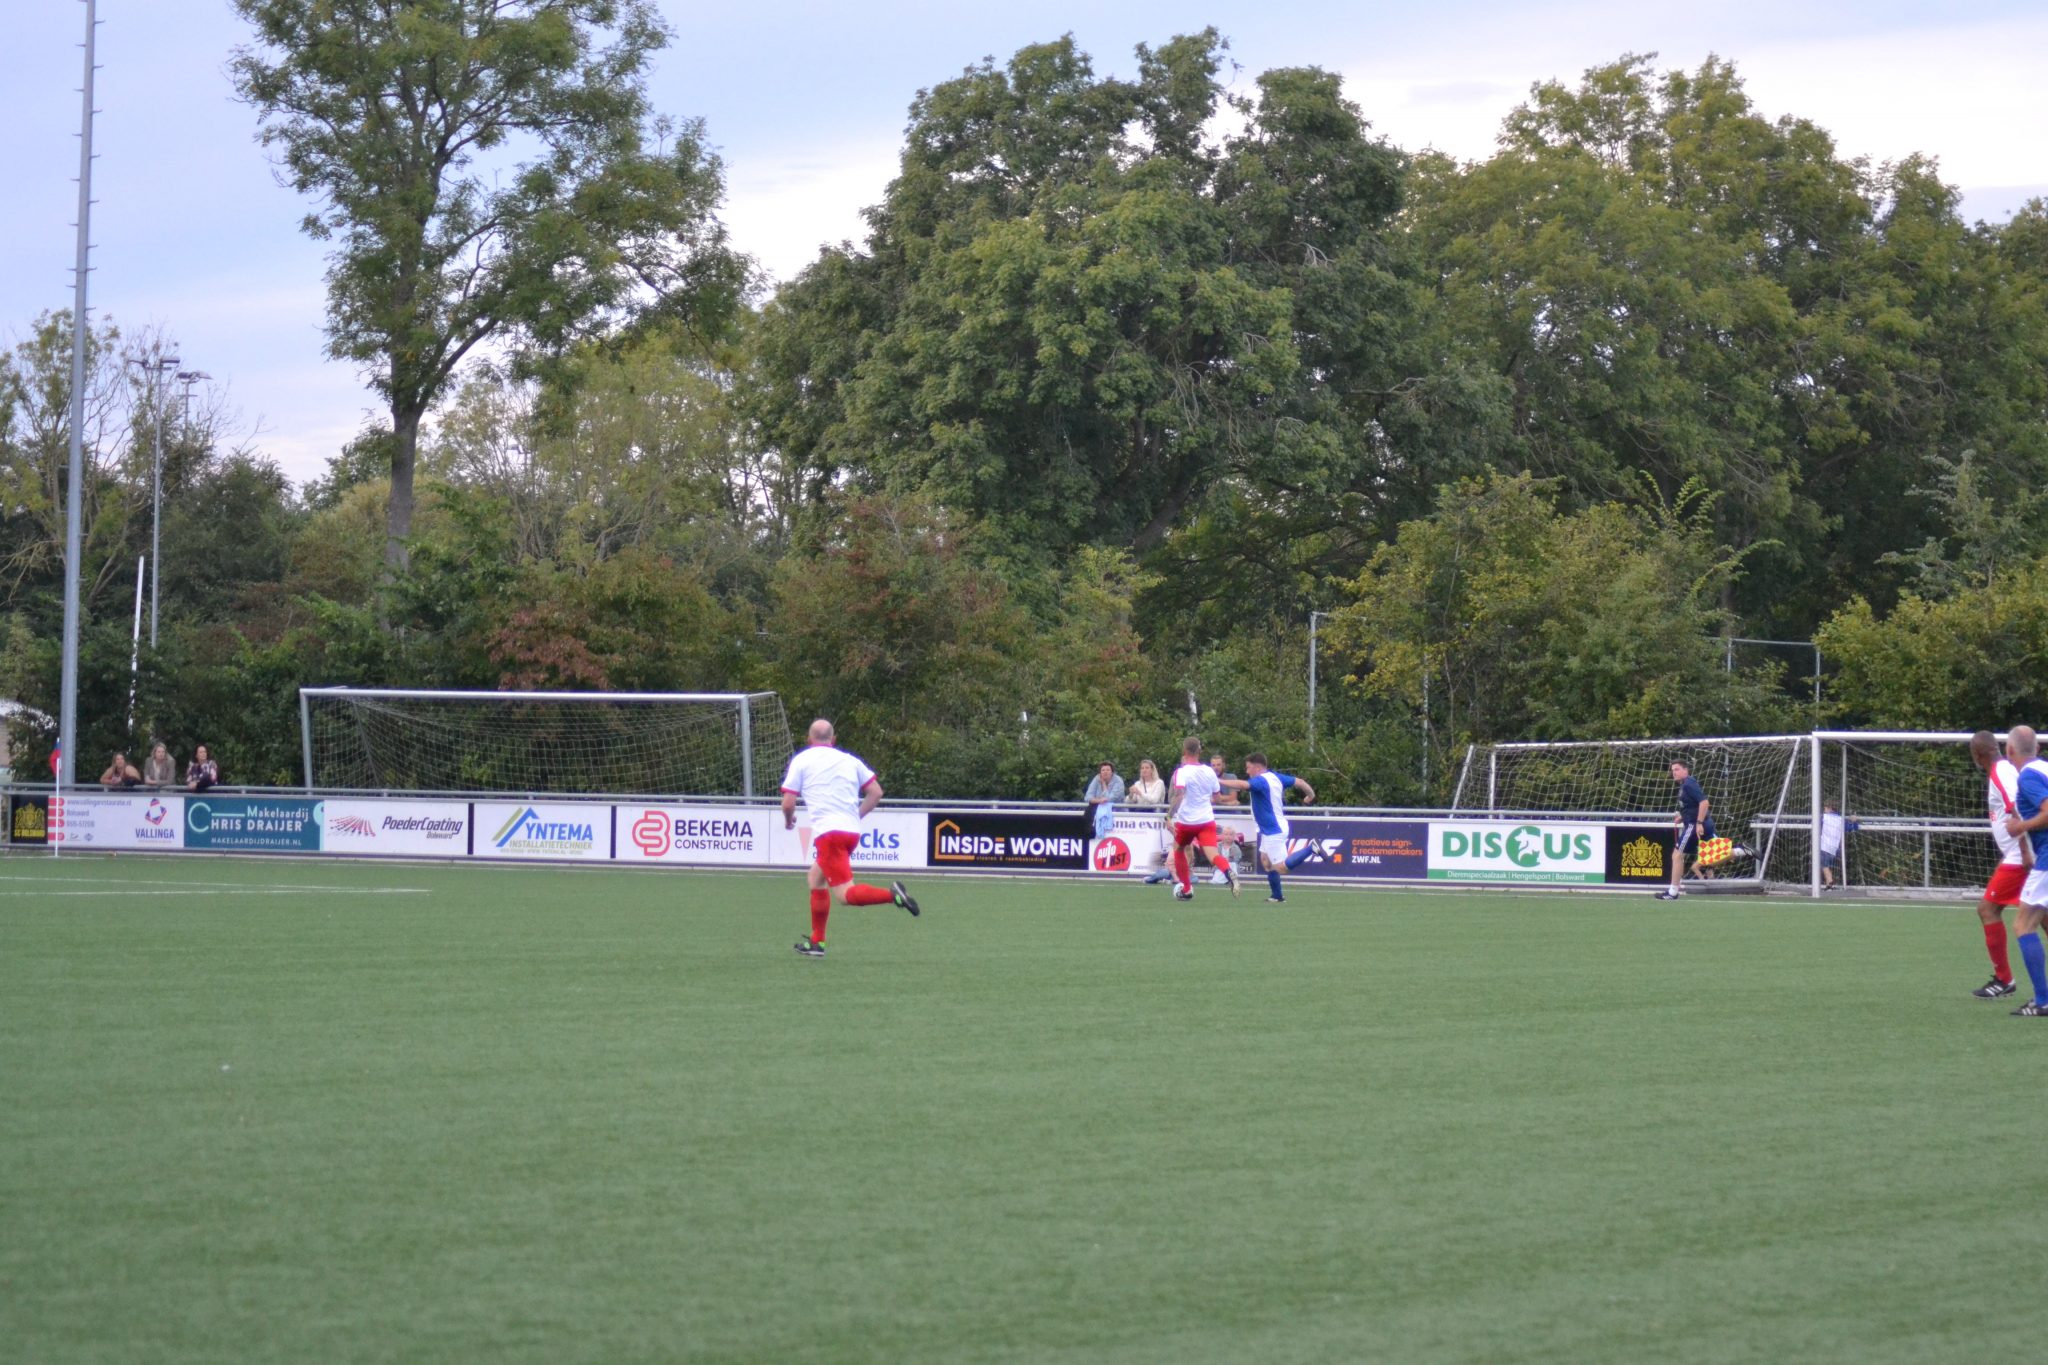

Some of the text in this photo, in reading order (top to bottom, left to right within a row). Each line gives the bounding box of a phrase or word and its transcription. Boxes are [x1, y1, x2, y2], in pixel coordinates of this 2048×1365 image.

[247, 805, 309, 822] Makelaardij
[247, 819, 302, 831] DRAIJER
[382, 816, 463, 835] PoederCoating
[675, 819, 753, 838] BEKEMA
[136, 828, 175, 839] VALLINGA
[525, 823, 593, 841] YNTEMA
[211, 837, 302, 846] MAKELAARDIJDRAIJER.NL
[675, 838, 753, 851] CONSTRUCTIE
[941, 835, 1083, 856] INSIDE WONEN
[1352, 838, 1391, 846] creatieve
[1443, 826, 1592, 868] DISCUS
[1352, 855, 1382, 864] ZWF.NL
[1511, 872, 1551, 881] Hengelsport
[1621, 867, 1630, 876] SC
